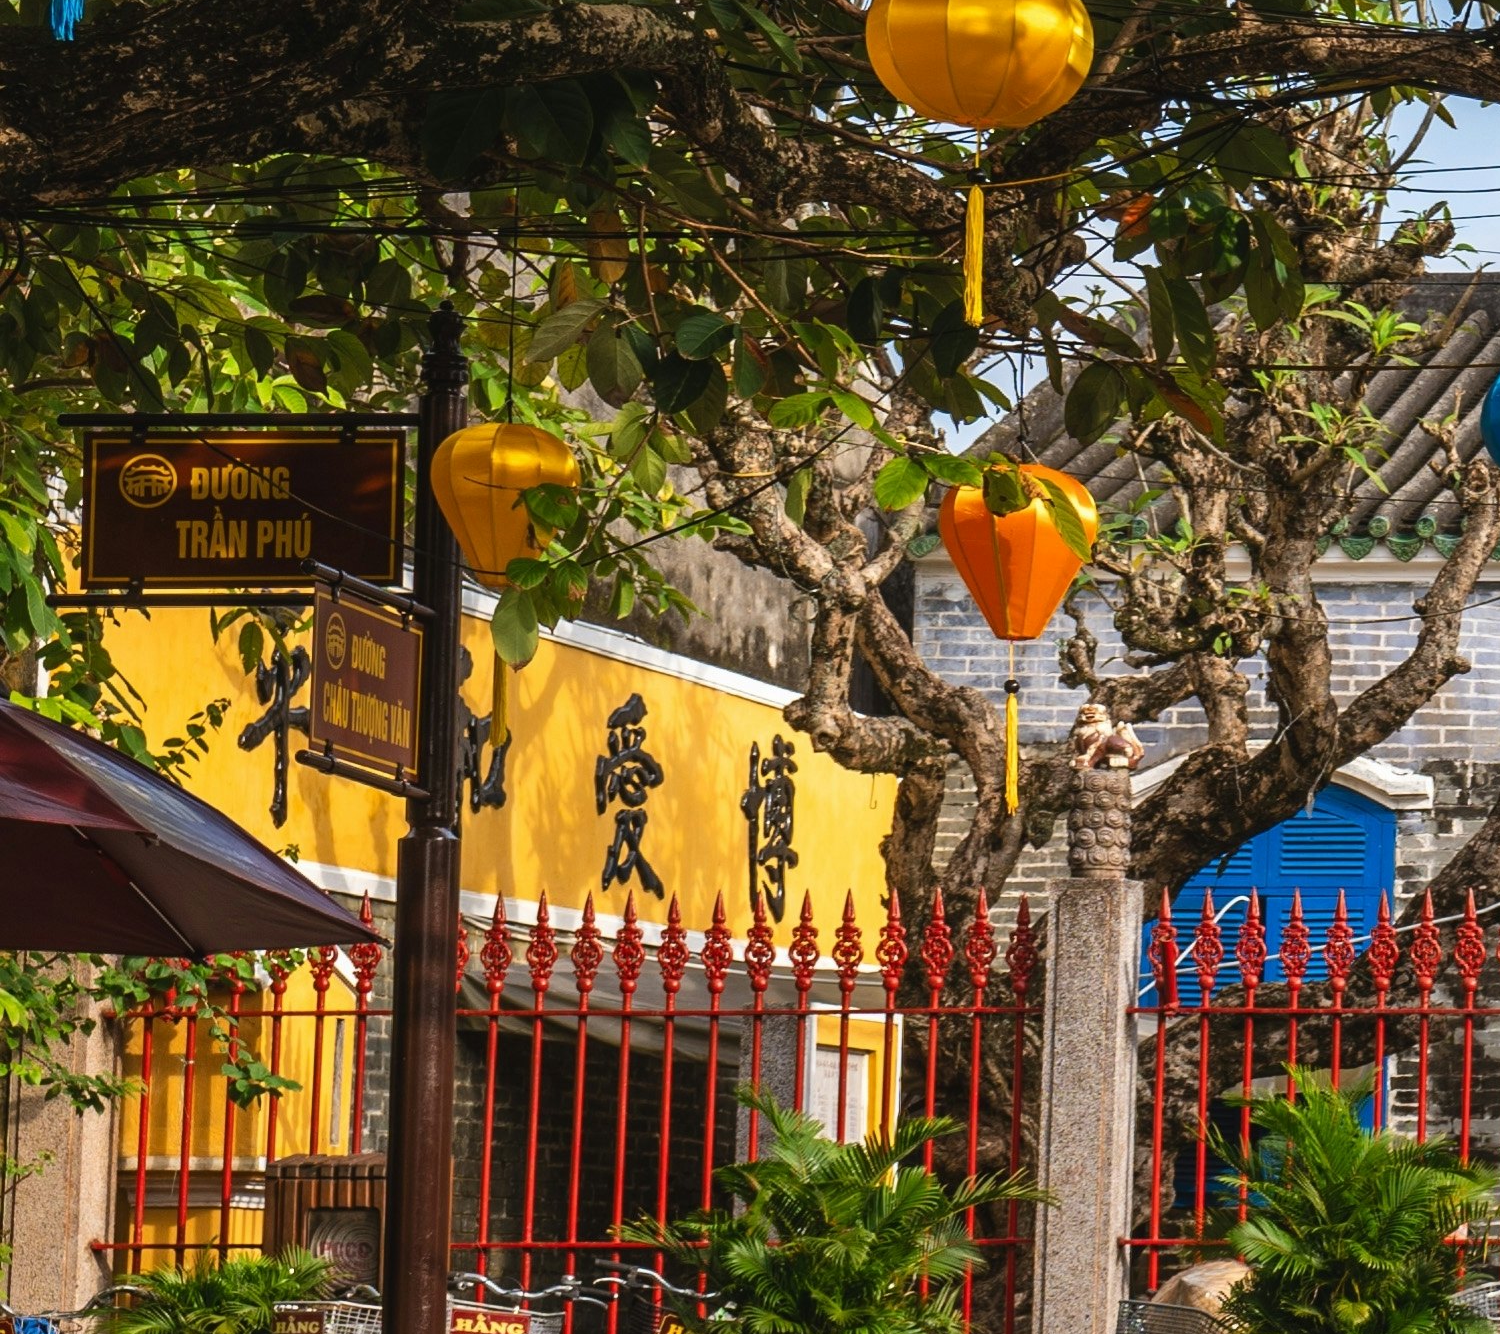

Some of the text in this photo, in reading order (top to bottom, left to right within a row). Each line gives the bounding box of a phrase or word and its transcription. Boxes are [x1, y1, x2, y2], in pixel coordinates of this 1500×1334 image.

[190, 458, 291, 501] ĐƯỜNG
[175, 506, 312, 559] TRẦN PHÚ
[350, 634, 386, 680] ĐƯỜNG
[322, 679, 411, 750] CHÂU THƯỢNG VĂN
